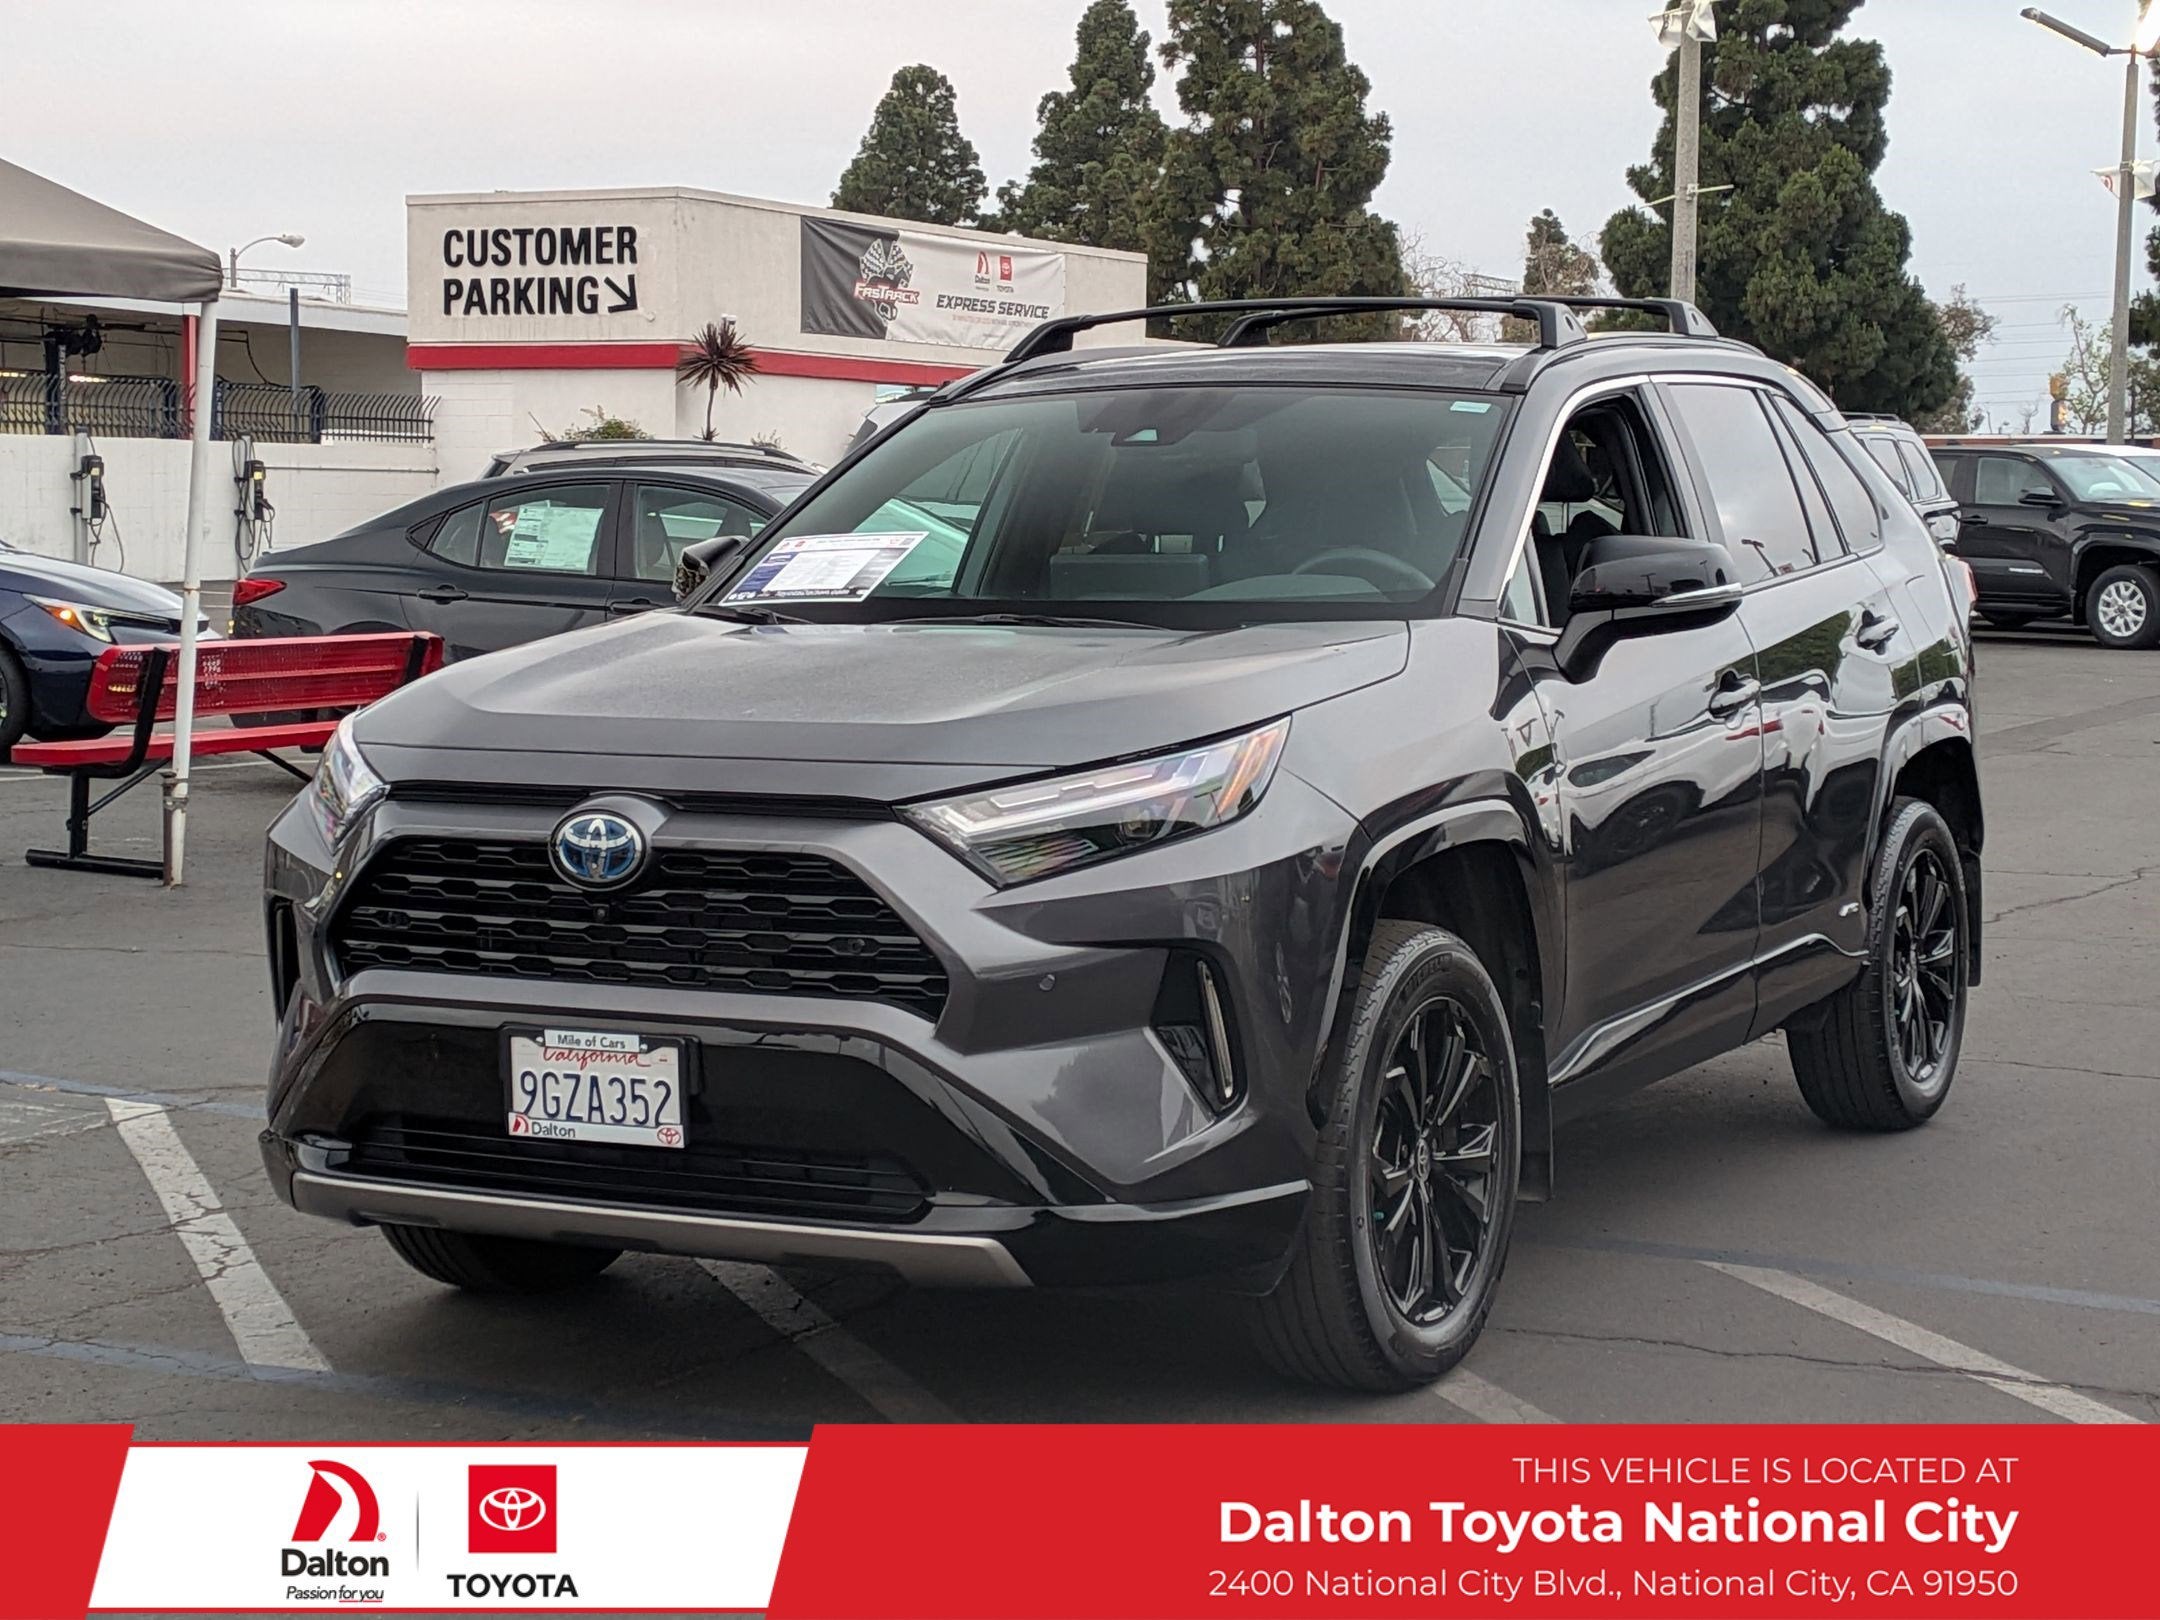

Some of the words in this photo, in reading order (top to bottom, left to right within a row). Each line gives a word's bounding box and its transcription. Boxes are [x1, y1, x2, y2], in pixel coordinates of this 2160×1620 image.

[443, 226, 638, 268] CUSTOMER
[443, 275, 599, 316] PARKING
[996, 285, 1014, 293] TOYOTA
[936, 294, 997, 315] EXPRESS
[997, 300, 1050, 320] SERVICE
[557, 1034, 581, 1047] Mile
[584, 1036, 598, 1048] of
[600, 1037, 626, 1050] Cars
[543, 1048, 651, 1070] California
[520, 1071, 672, 1128] 9GZA352
[531, 1121, 577, 1139] Dalton
